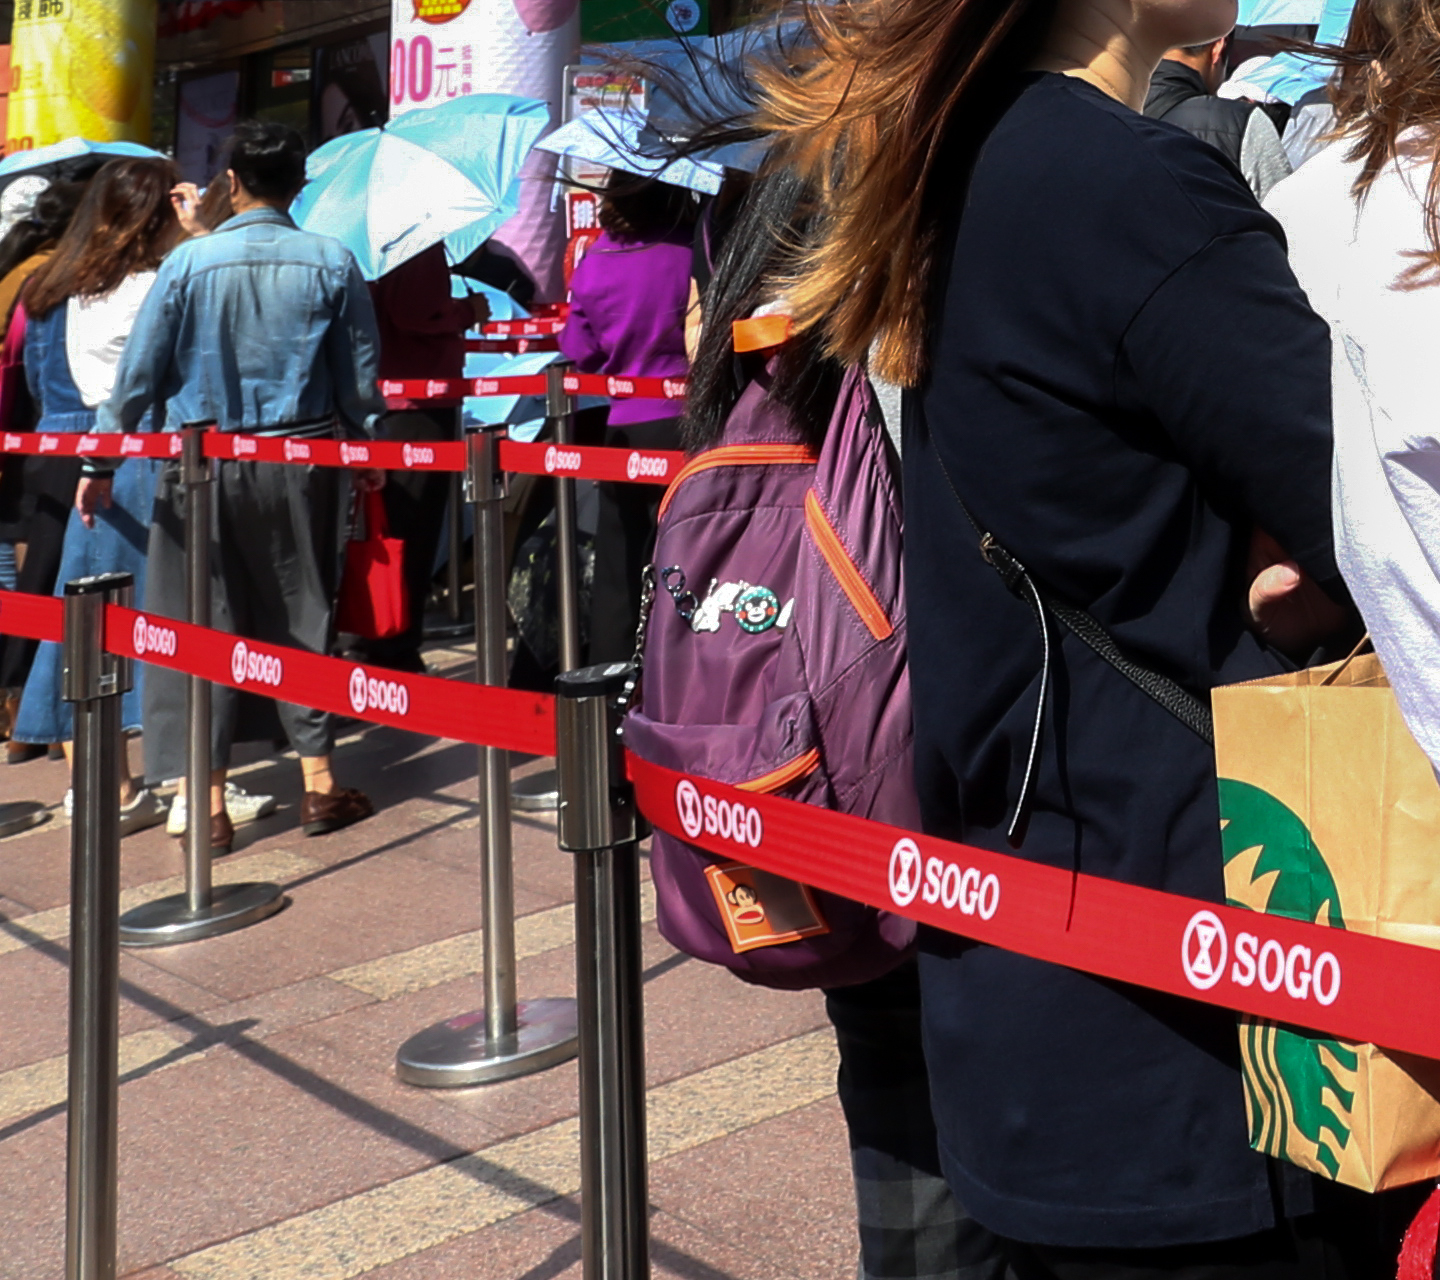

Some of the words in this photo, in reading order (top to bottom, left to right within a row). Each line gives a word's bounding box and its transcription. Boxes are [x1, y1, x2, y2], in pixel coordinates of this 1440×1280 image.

[349, 444, 369, 463] SOGO
[412, 446, 434, 465] SOGO
[557, 449, 581, 471] SOGO
[641, 456, 668, 478] SOGO
[147, 624, 177, 656] SOGO
[248, 650, 282, 686] SOGO
[368, 677, 408, 715] SOGO
[704, 795, 762, 848] SOGO
[922, 857, 1001, 921] SOGO
[1233, 935, 1341, 1006] SOGO
